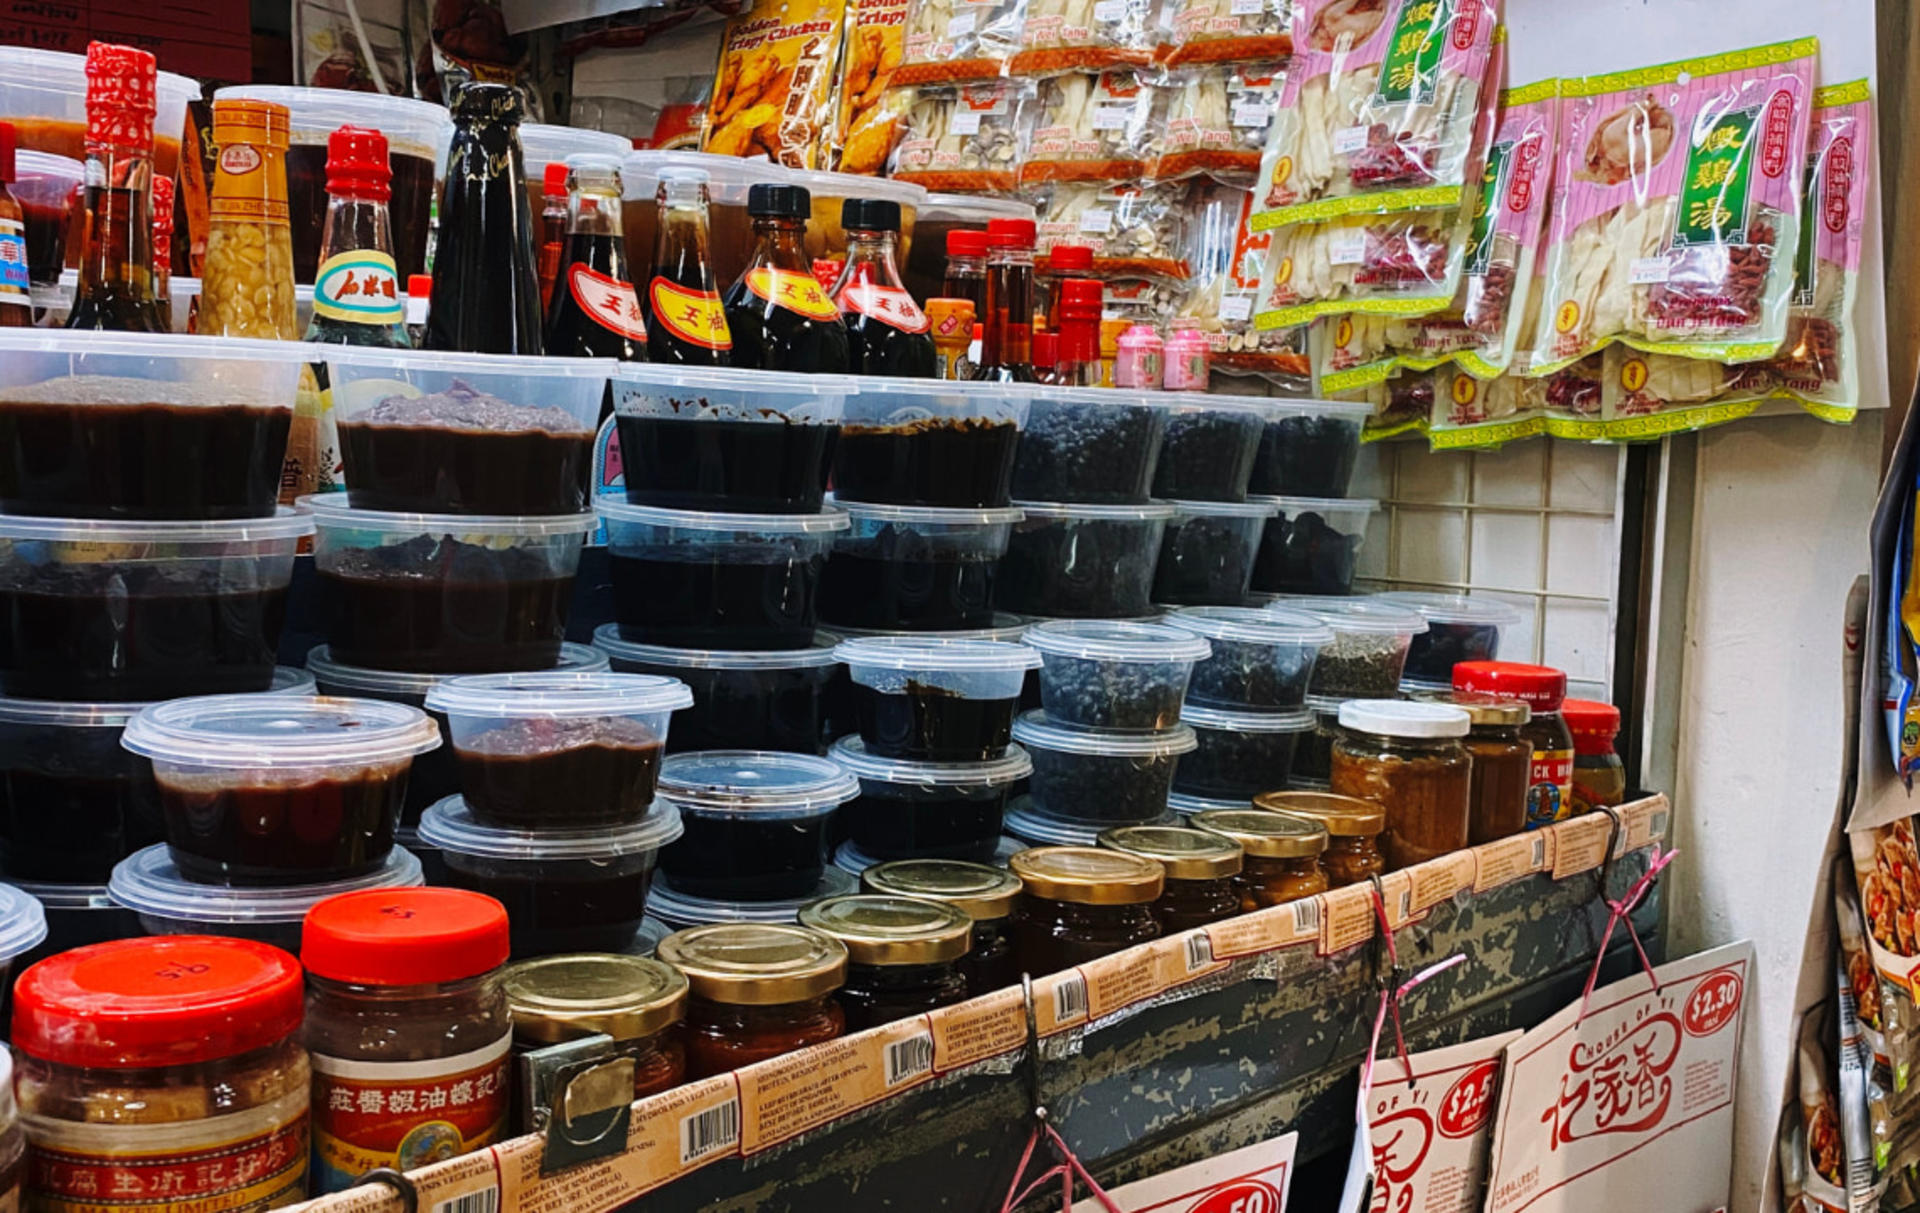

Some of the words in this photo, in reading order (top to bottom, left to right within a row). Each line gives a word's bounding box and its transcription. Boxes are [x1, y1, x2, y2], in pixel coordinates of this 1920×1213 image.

[730, 17, 781, 37] Golden
[768, 20, 832, 42] Chicken
[1062, 27, 1088, 39] Tang
[1211, 17, 1240, 30] Tang
[1071, 141, 1099, 153] Tang
[1201, 130, 1232, 144] Tang
[783, 283, 821, 303] 王油
[677, 304, 725, 331] 王油
[876, 298, 915, 318] 王油
[1708, 313, 1746, 327] Tang
[1784, 379, 1822, 393] Tang
[1533, 766, 1550, 778] CK
[1690, 979, 1737, 1023] $2.30
[1585, 1021, 1629, 1060] HOUSE
[1636, 1003, 1650, 1021] OF
[1661, 997, 1674, 1010] YI
[1377, 1095, 1398, 1114] OF
[1413, 1089, 1429, 1104] YI
[1448, 1073, 1494, 1122] $2.5
[519, 1189, 556, 1212] PRODUCT
[571, 1165, 611, 1188] SINGAPORE
[166, 1192, 247, 1213] LIMITED
